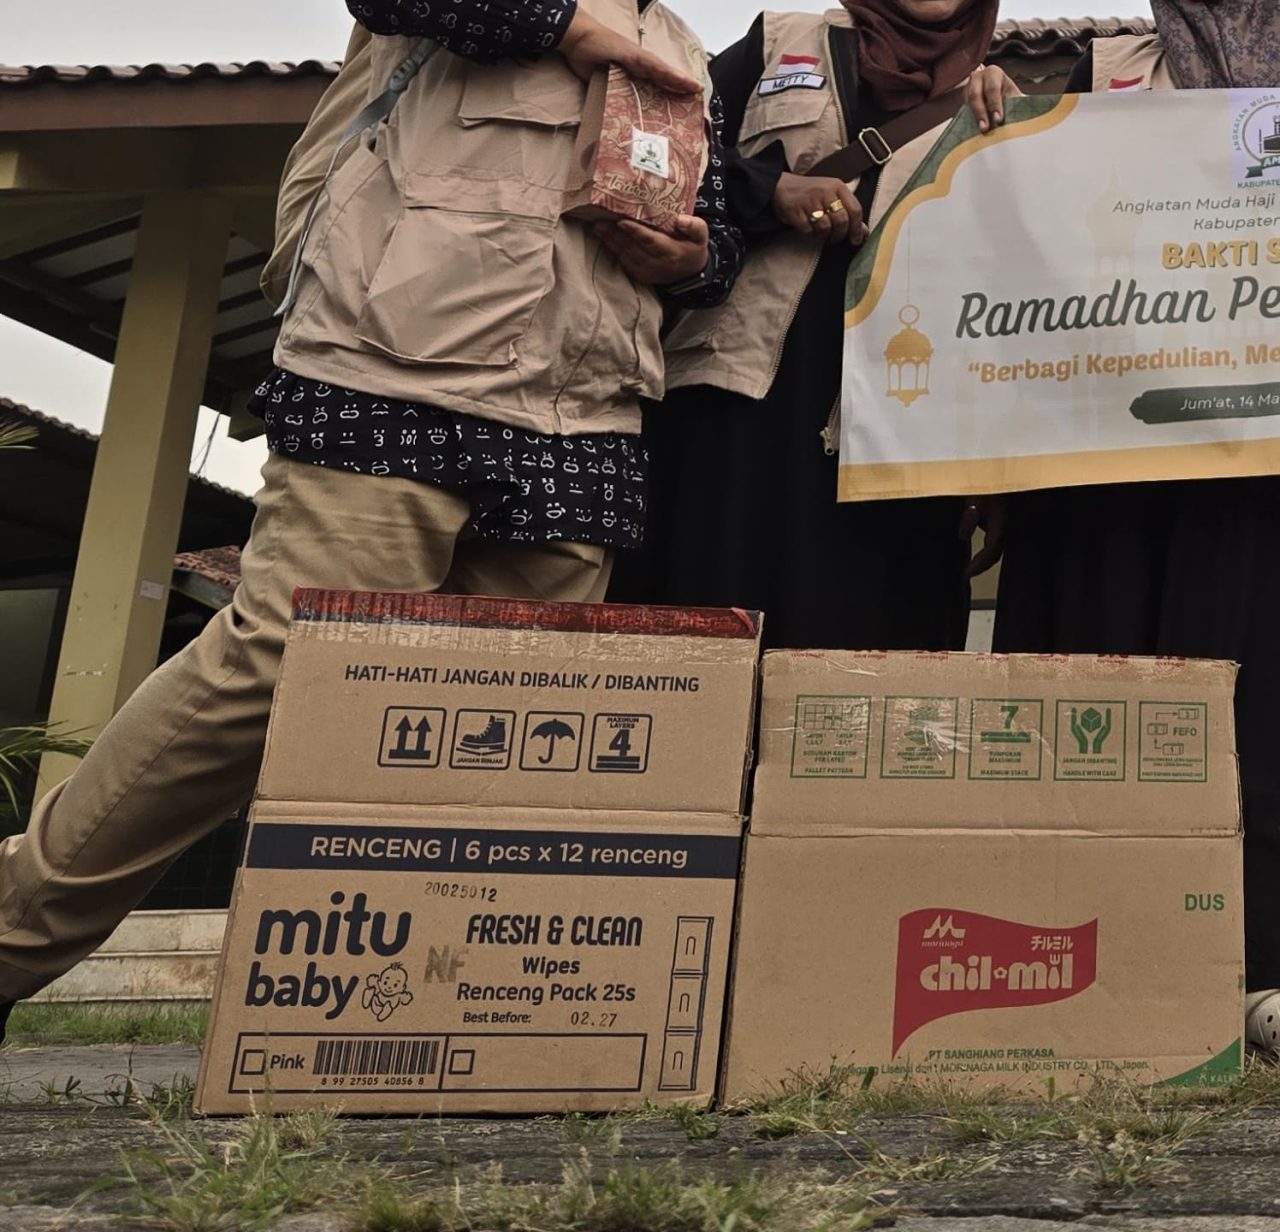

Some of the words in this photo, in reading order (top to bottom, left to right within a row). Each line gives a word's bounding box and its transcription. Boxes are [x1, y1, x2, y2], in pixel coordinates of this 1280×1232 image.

[773, 75, 809, 89] METTY
[1112, 198, 1192, 214] Angkatan
[1196, 197, 1241, 210] Muda
[1245, 193, 1275, 209] Haji
[1161, 239, 1257, 269] BAKTI
[955, 278, 1216, 339] Ramadhan
[1086, 346, 1238, 377] Kepedulian,
[1180, 395, 1236, 412] Jum'at,
[1239, 395, 1254, 407] 14
[344, 664, 438, 683] HATI-HATI
[440, 669, 515, 687] JANGAN
[519, 671, 588, 689] DIBALIK
[604, 675, 700, 693] DIBANTING
[1000, 705, 1019, 729] 7
[608, 729, 631, 756] 4
[1172, 727, 1198, 737] FEFO
[310, 836, 442, 859] RENCENG
[465, 840, 481, 860] 6
[487, 844, 531, 866] pcs
[537, 847, 552, 863] x
[560, 842, 584, 863] 12
[590, 848, 689, 869] renceng
[424, 881, 498, 903] 20025012
[1184, 893, 1225, 911] DUS
[254, 891, 412, 956] mitu
[466, 914, 541, 945] FRESH
[546, 914, 564, 945] &
[570, 916, 643, 947] CLEAN
[1030, 935, 1074, 951] チルミル
[522, 956, 581, 979] Wipes
[245, 961, 360, 1020] baby
[456, 982, 544, 1005] Renceng
[550, 983, 598, 1001] Pack
[602, 984, 636, 1001] 25s
[463, 1011, 489, 1023] Best
[491, 1011, 532, 1024] Before:
[571, 1011, 618, 1028] 02.27
[270, 1054, 306, 1069] Pink
[929, 1049, 942, 1059] PT
[944, 1049, 1004, 1059] SANGHIANG
[1007, 1048, 1055, 1058] PERKASA
[997, 1062, 1020, 1072] MILK
[1021, 1060, 1071, 1072] INDUSTRY
[332, 1076, 345, 1086] 99
[350, 1076, 379, 1086] 27505
